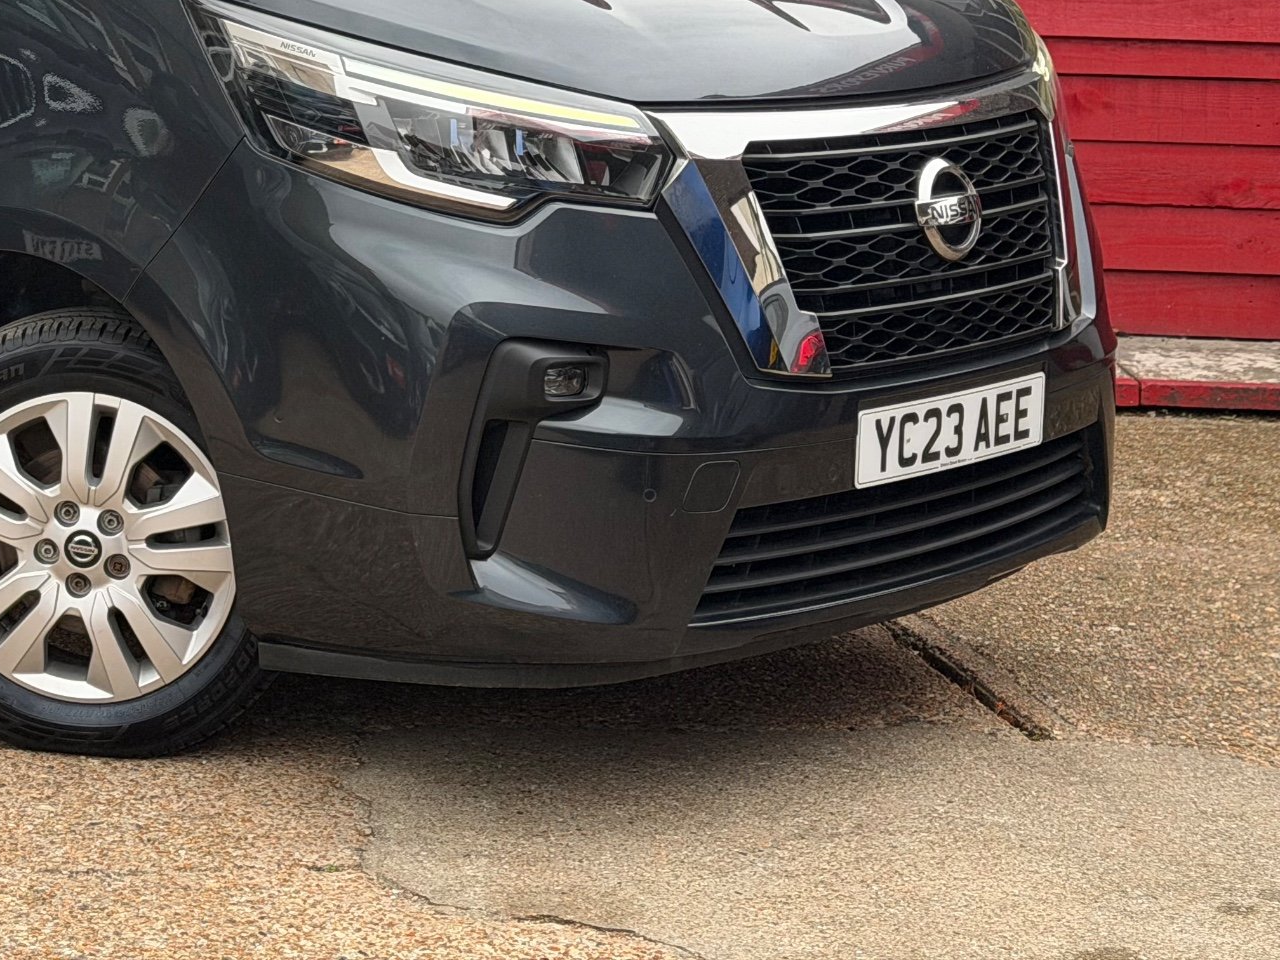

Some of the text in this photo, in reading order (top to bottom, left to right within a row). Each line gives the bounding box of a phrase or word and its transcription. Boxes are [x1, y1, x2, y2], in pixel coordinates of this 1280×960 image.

[280, 41, 317, 57] NISSAN
[930, 199, 978, 220] NISSA
[875, 386, 1032, 473] YC23 AEE
